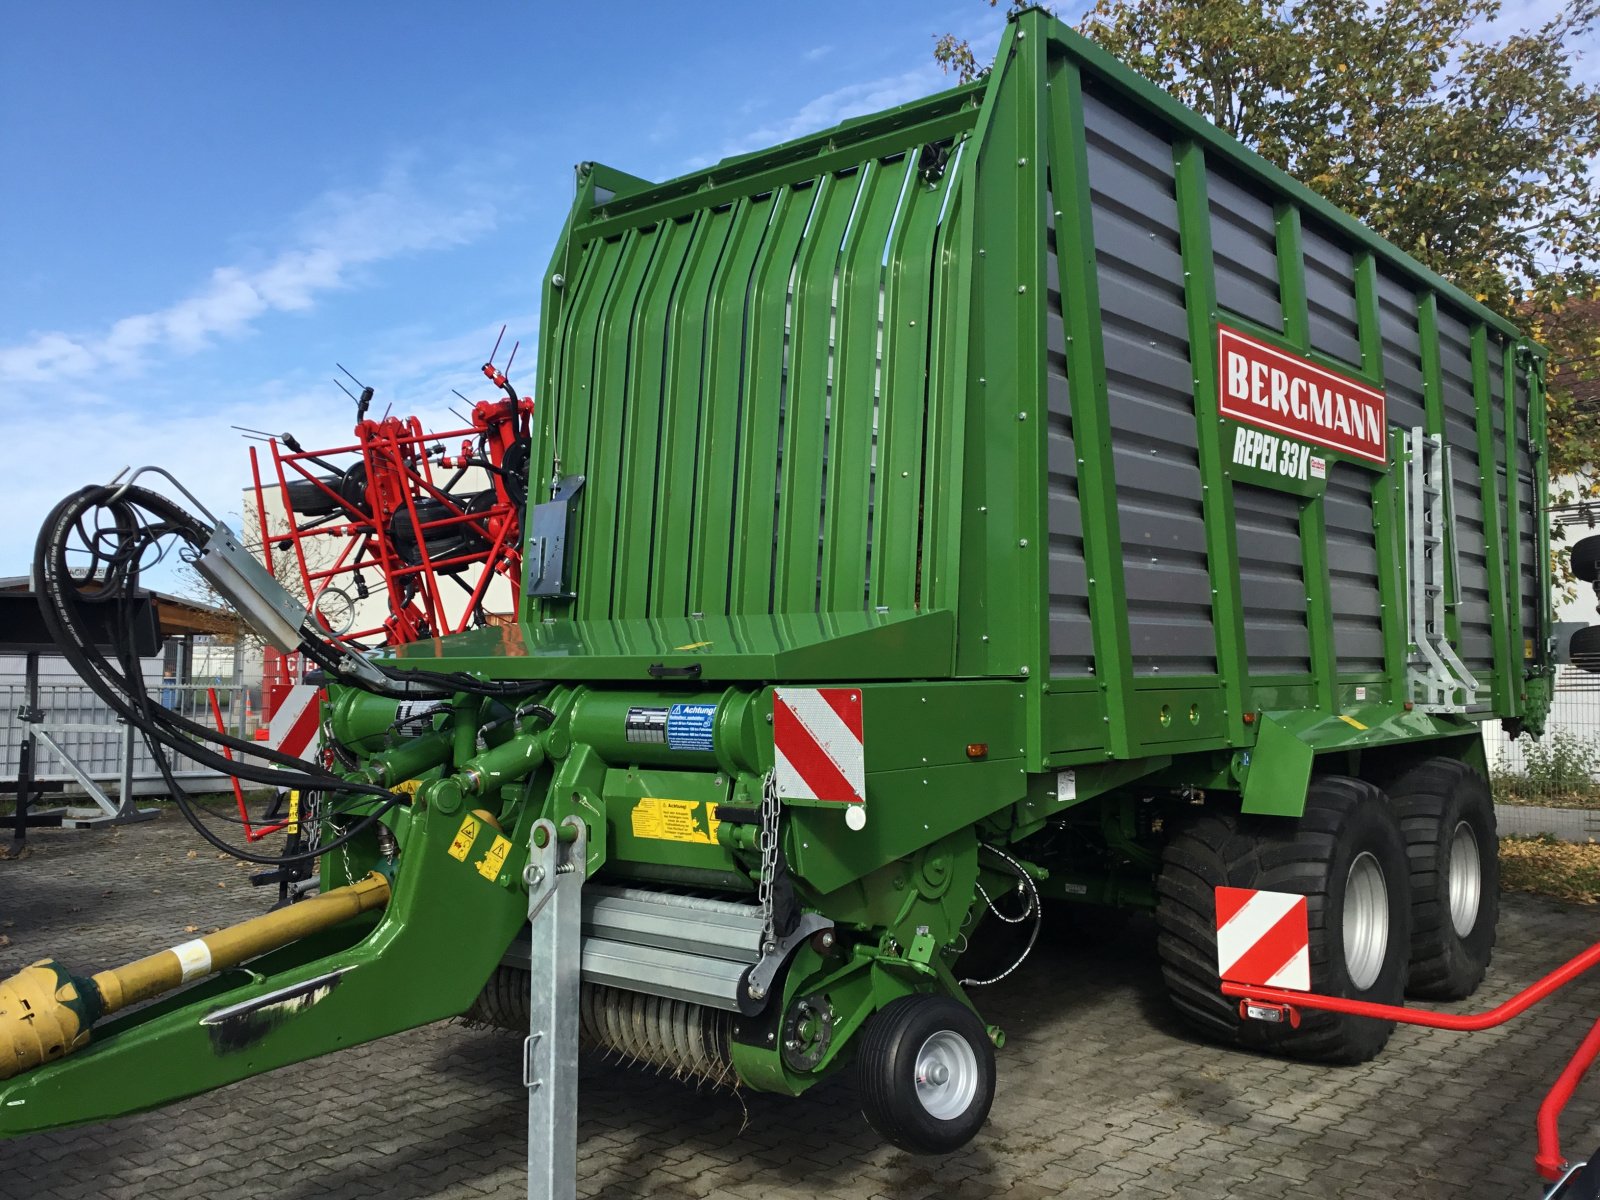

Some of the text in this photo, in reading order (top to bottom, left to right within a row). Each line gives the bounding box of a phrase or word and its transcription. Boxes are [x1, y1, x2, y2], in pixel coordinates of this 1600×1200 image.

[1228, 350, 1381, 446] BERGMANN
[1232, 426, 1280, 473] REPEX
[683, 706, 717, 715] Achtung!
